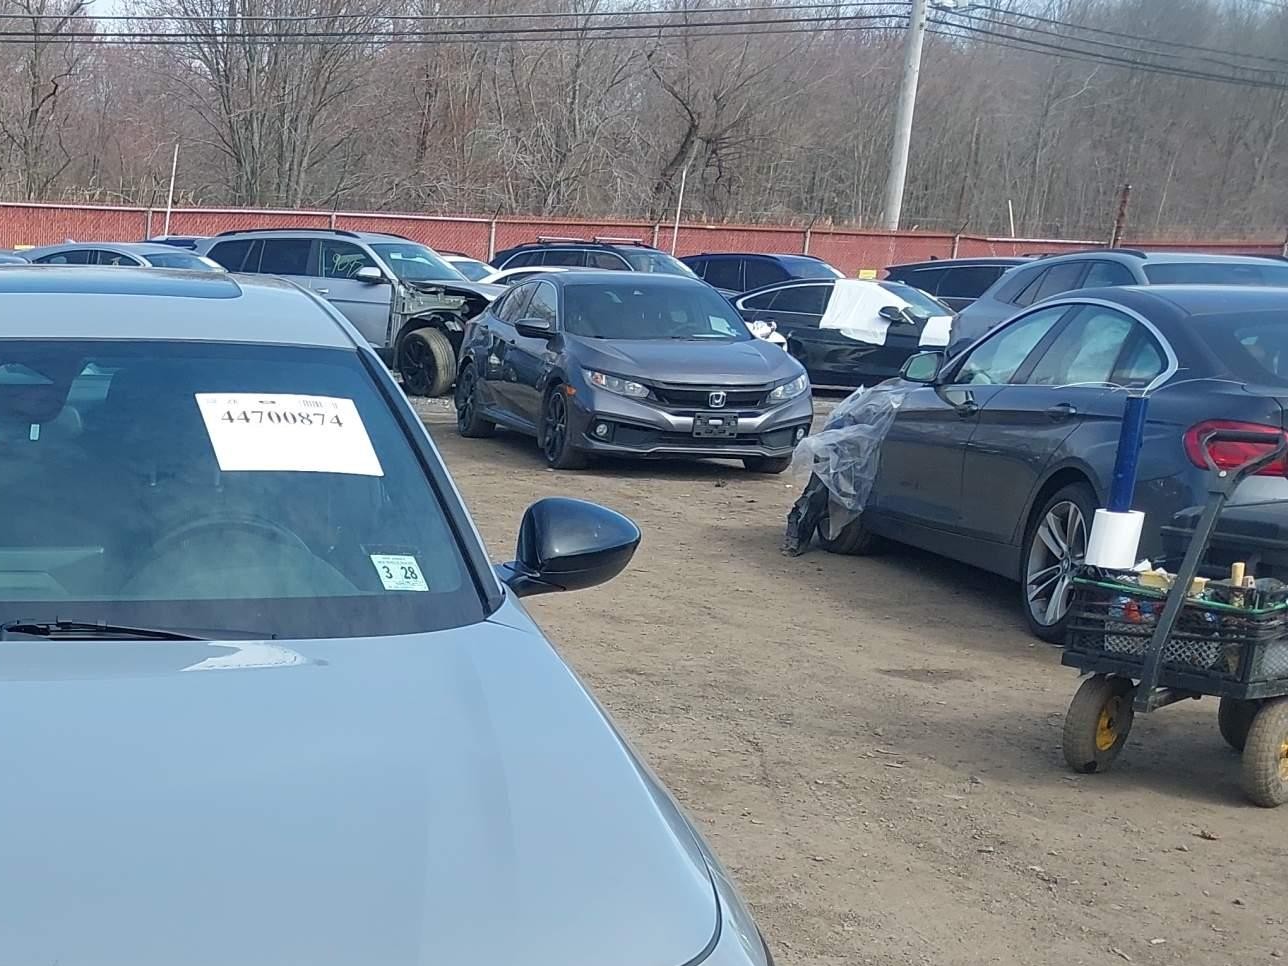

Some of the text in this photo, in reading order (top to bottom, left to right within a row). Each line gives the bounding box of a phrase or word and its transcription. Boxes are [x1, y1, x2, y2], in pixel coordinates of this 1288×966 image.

[221, 410, 343, 428] 44700874
[382, 565, 418, 580] 3 28
